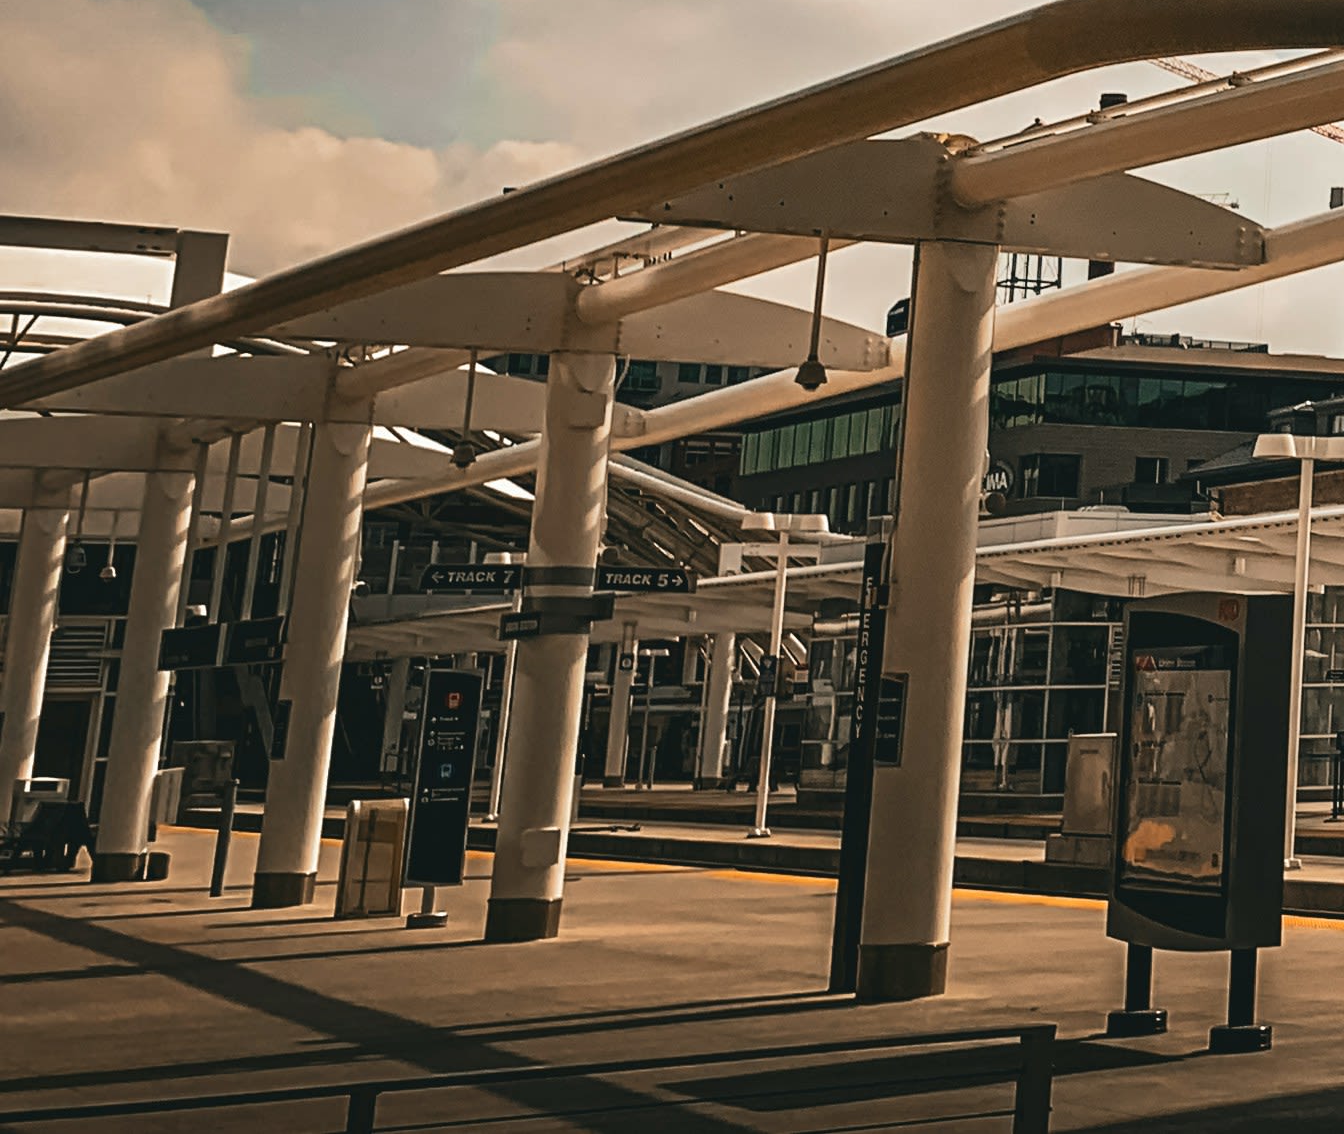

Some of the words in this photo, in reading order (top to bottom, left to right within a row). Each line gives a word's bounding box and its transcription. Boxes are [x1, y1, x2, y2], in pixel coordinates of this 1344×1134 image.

[448, 570, 495, 583] TRACK
[503, 570, 515, 584] 7
[605, 573, 651, 585] TRACK
[657, 573, 669, 587] 5
